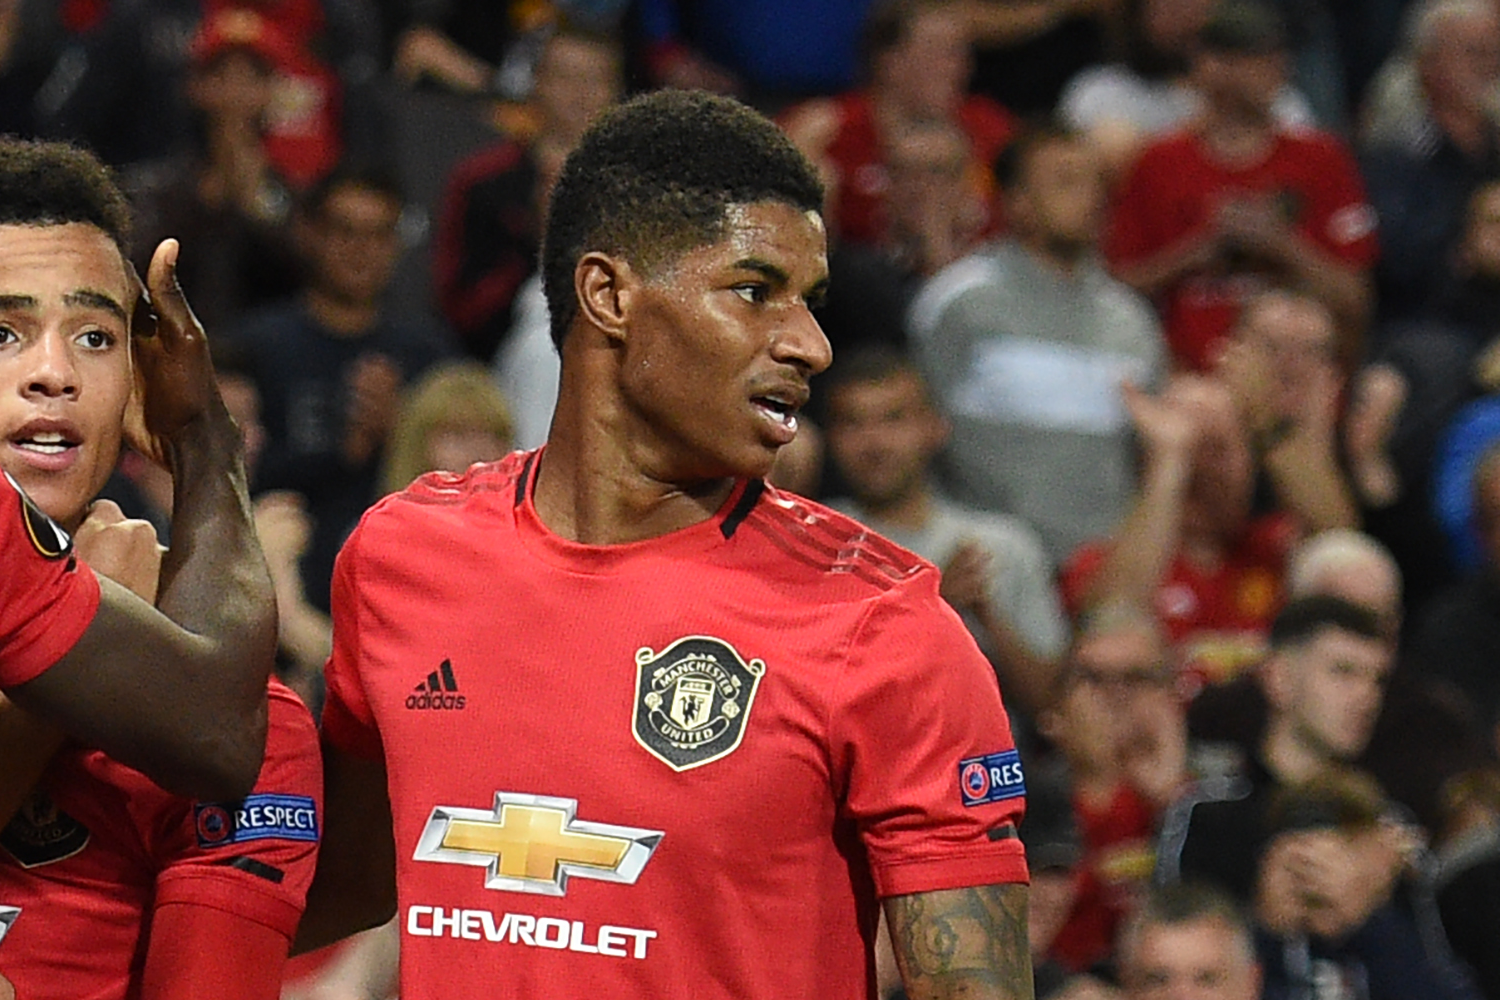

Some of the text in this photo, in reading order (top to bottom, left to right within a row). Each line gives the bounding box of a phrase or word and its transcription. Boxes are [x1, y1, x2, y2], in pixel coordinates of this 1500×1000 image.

[659, 660, 735, 696] MANCHESTER
[405, 692, 467, 711] adidas
[661, 722, 714, 743] UNITED
[234, 805, 316, 830] RESPECT
[406, 904, 658, 960] CHEVROLET
